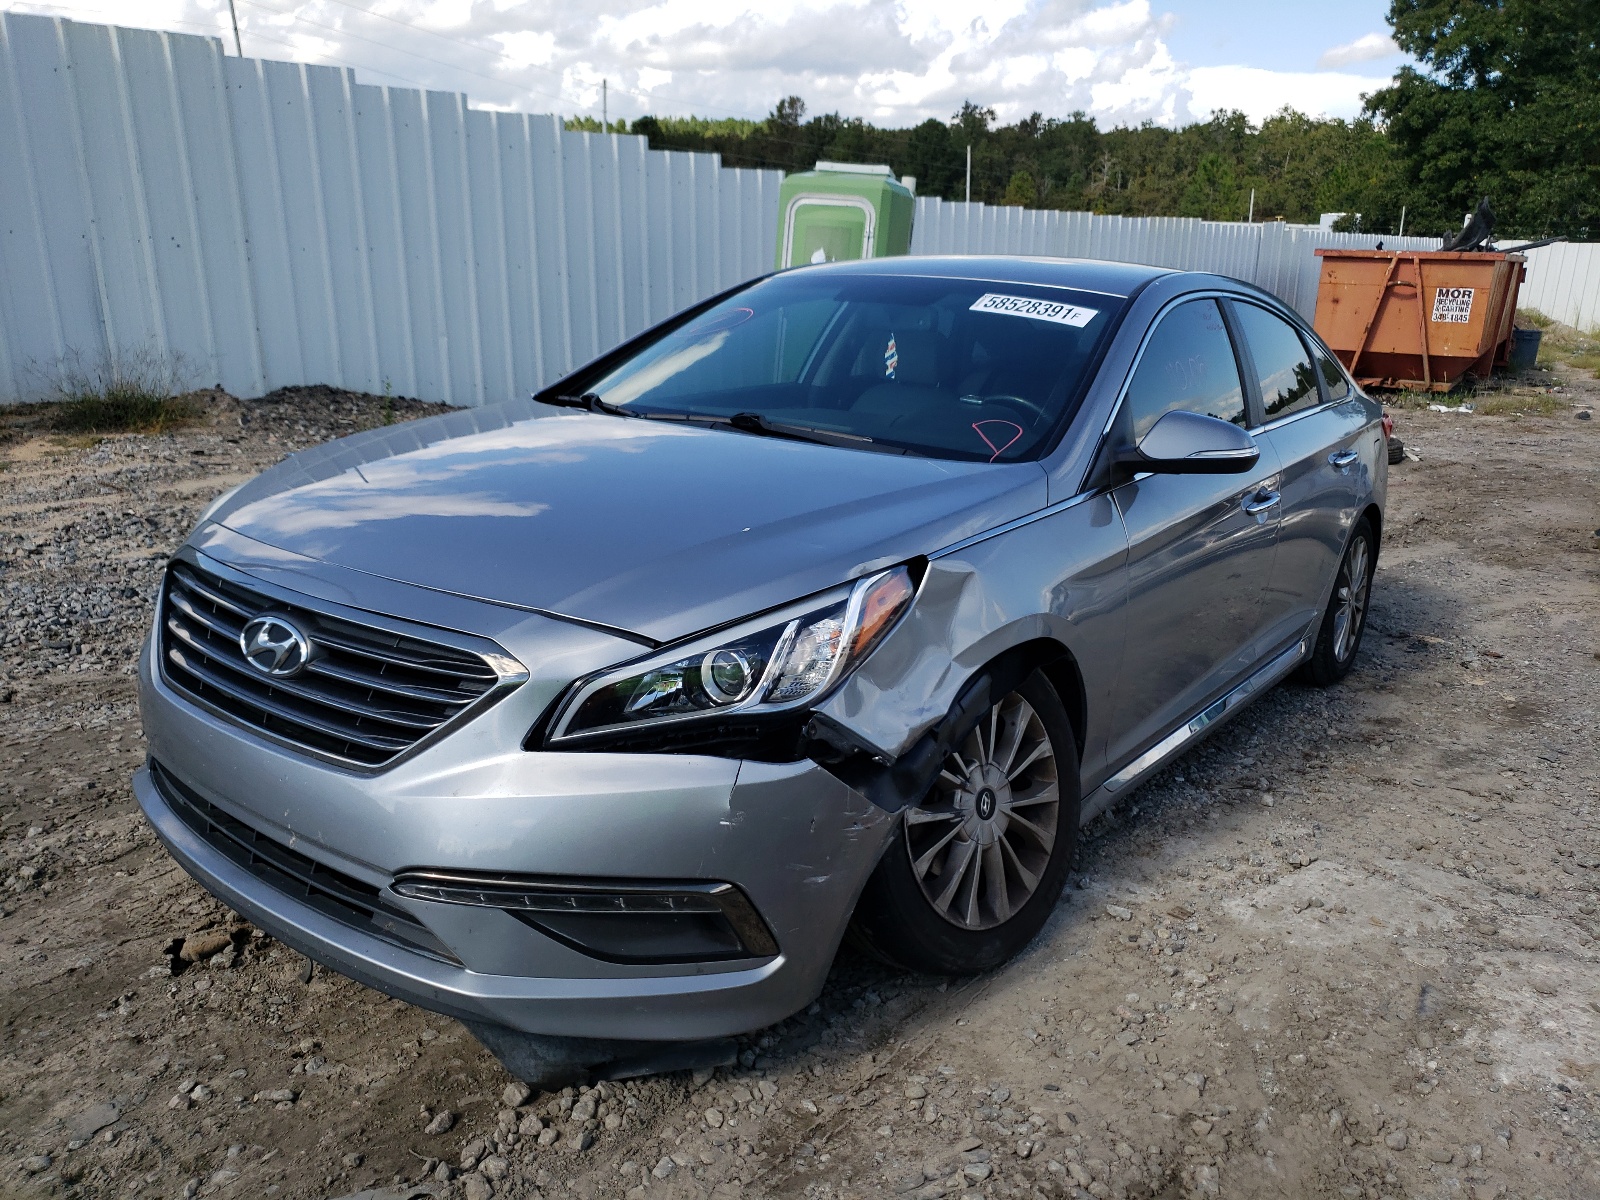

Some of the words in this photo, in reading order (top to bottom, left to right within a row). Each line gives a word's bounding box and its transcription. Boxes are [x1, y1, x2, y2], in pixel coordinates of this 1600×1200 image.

[1437, 288, 1473, 299] MOR
[1436, 298, 1471, 307] RECYCLING
[984, 296, 1075, 320] 58528391
[1441, 305, 1470, 313] CARTING
